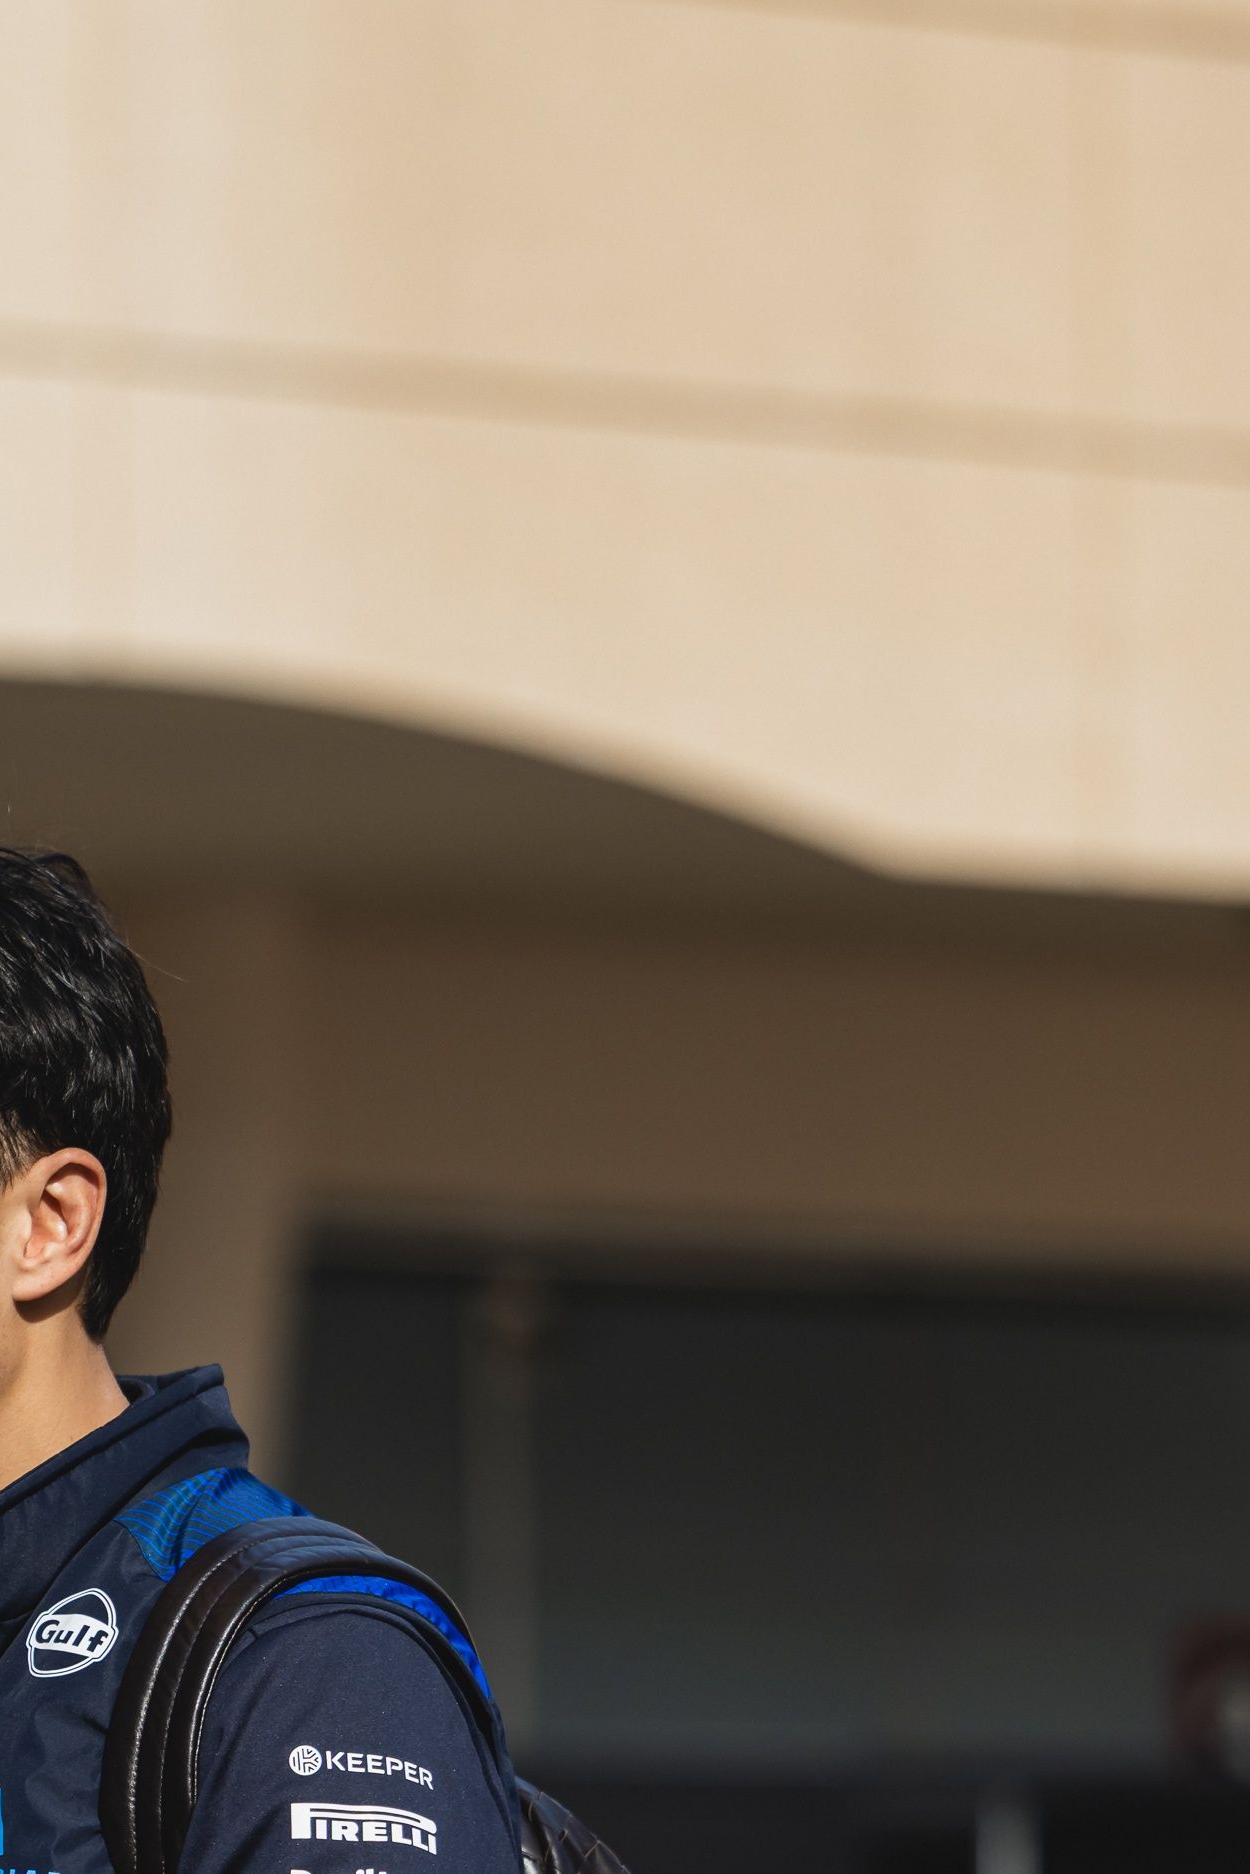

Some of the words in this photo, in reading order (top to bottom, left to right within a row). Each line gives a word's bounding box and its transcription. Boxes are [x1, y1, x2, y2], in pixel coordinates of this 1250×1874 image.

[35, 1619, 109, 1653] Gulf
[325, 1750, 434, 1791] KEEPER
[290, 1802, 437, 1856] PIRELLI
